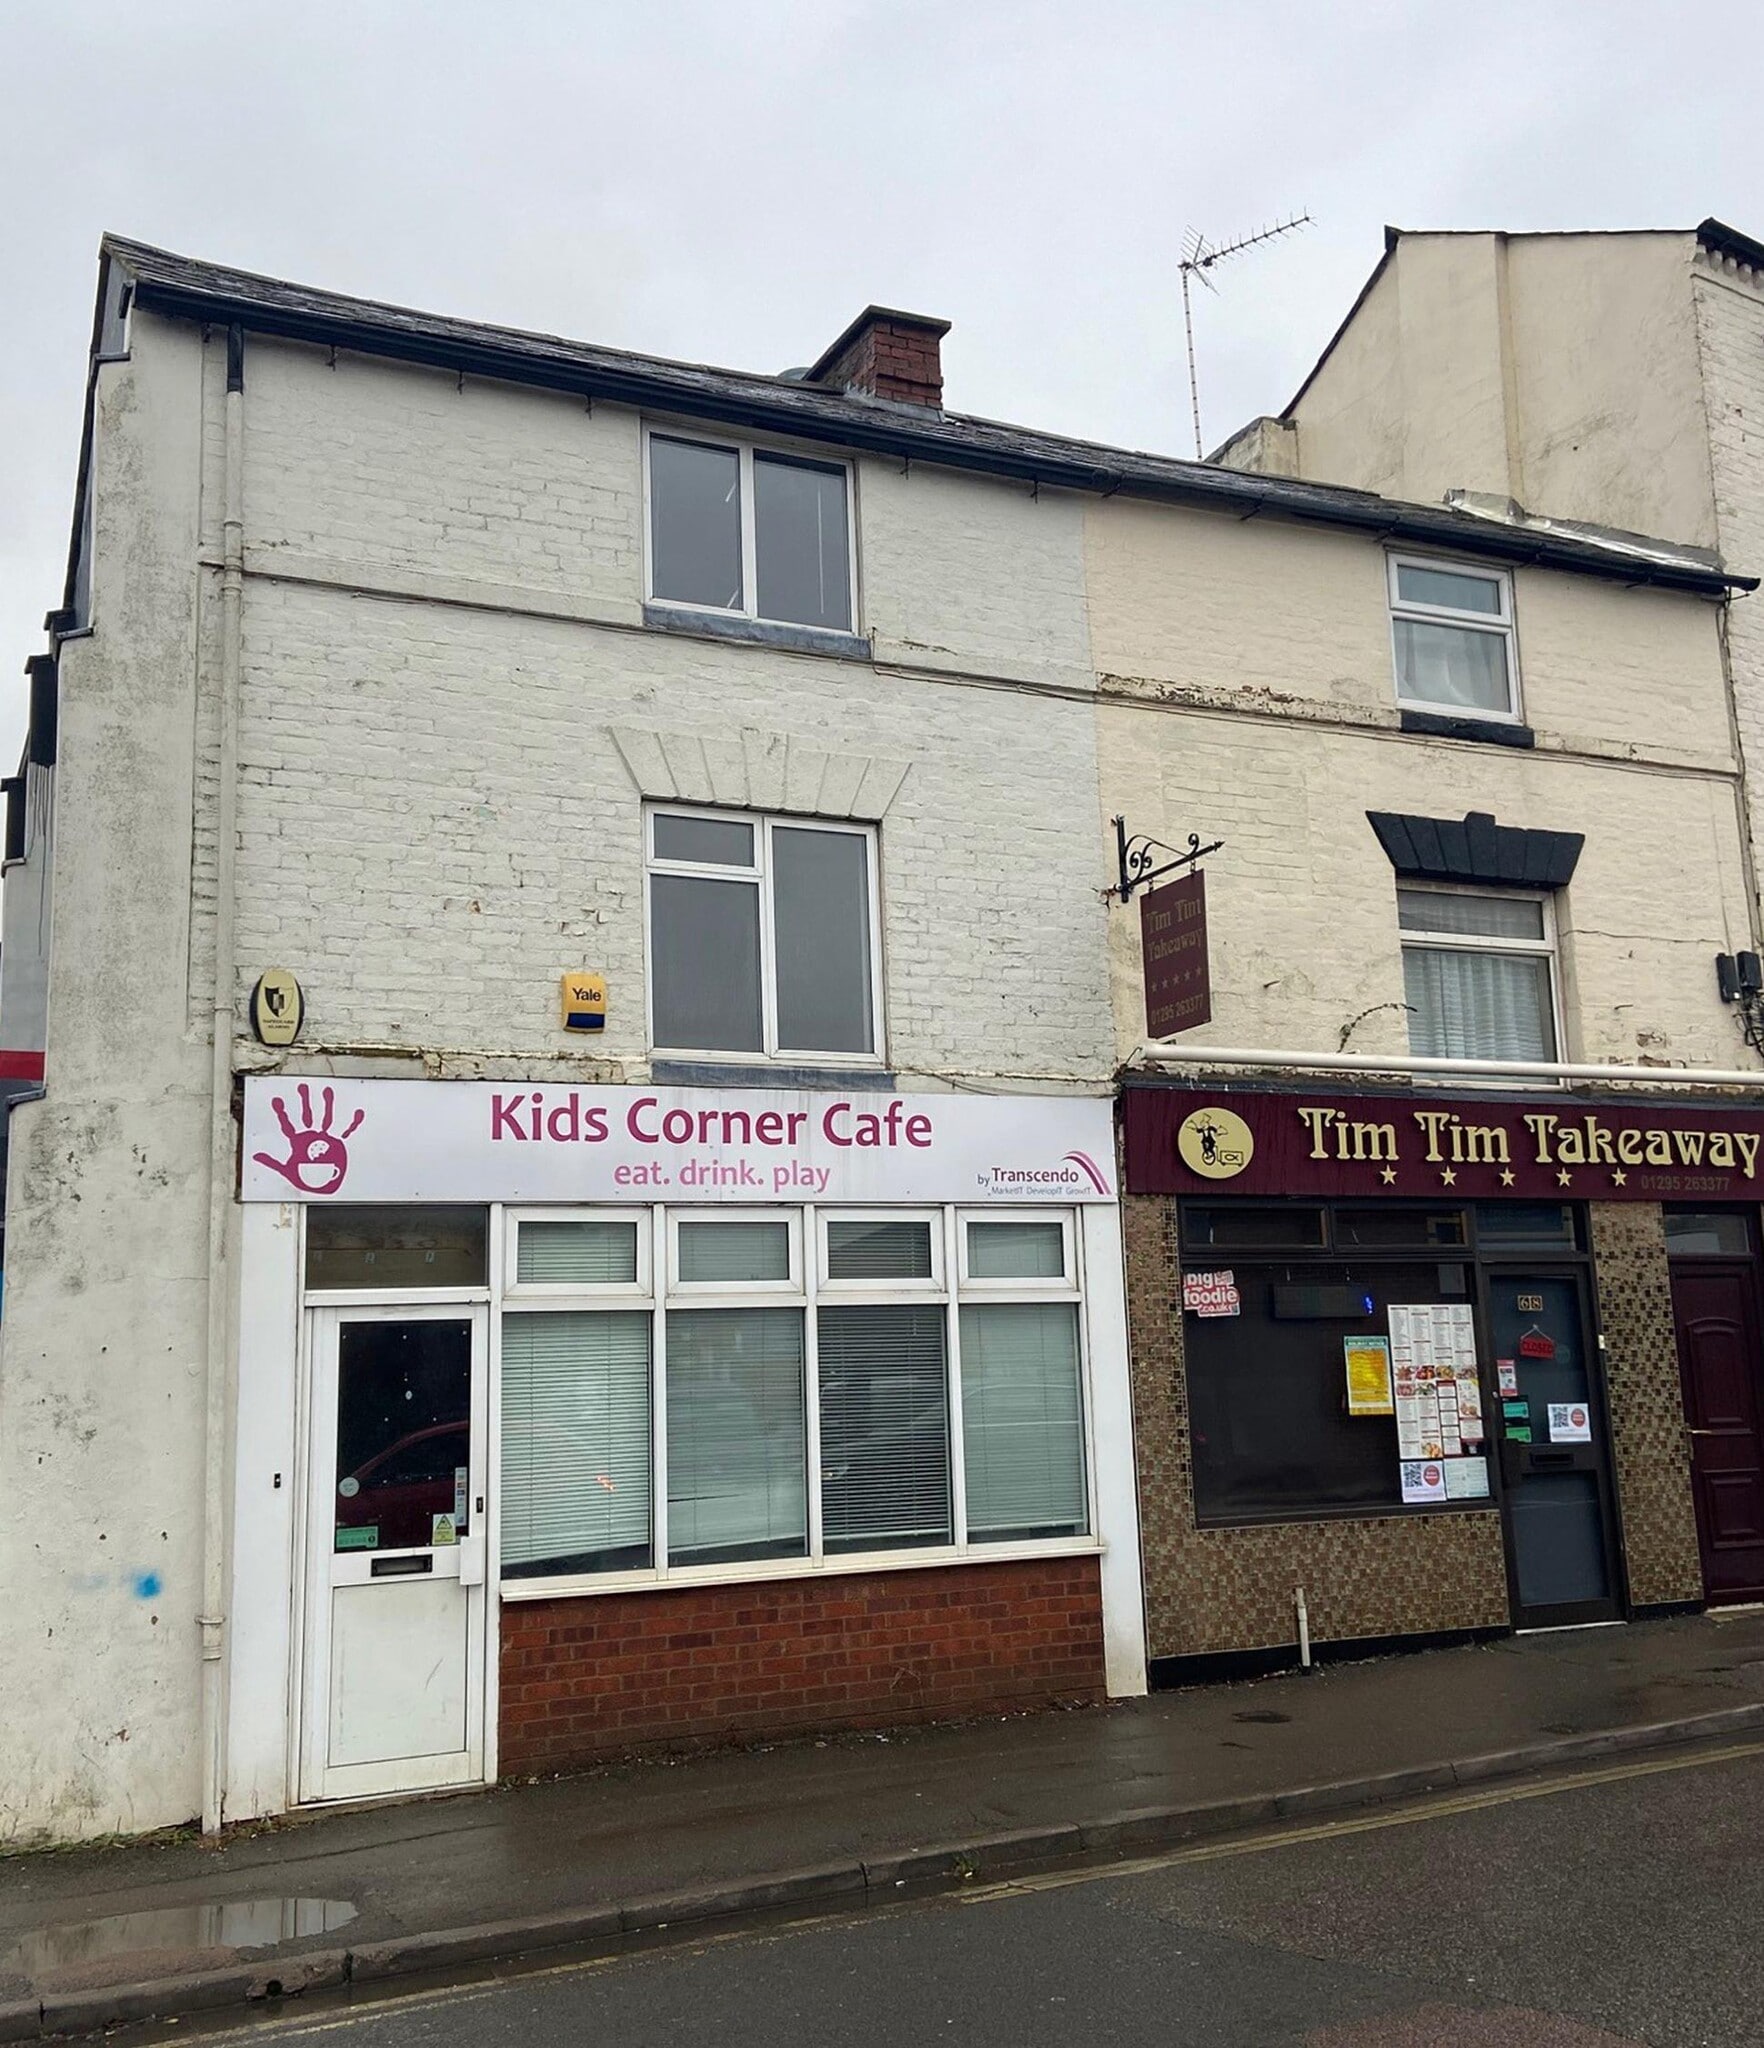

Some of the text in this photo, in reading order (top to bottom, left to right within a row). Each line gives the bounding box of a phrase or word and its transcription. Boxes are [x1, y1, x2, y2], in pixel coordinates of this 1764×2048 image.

[1146, 899, 1201, 932] Tim Tim
[1147, 927, 1204, 961] Takeaway
[572, 987, 602, 1001] Yale
[1151, 993, 1204, 1025] 01295 263377
[490, 1092, 933, 1148] Kids Corner Cafe
[1298, 1107, 1760, 1179] Tim Tim Takeaway
[613, 1159, 831, 1193] eat. drink. play
[977, 1168, 1079, 1187] by Transcendo
[1640, 1175, 1730, 1191] 01295 263377
[1183, 1286, 1239, 1305] foodie
[1519, 1296, 1541, 1310] 68
